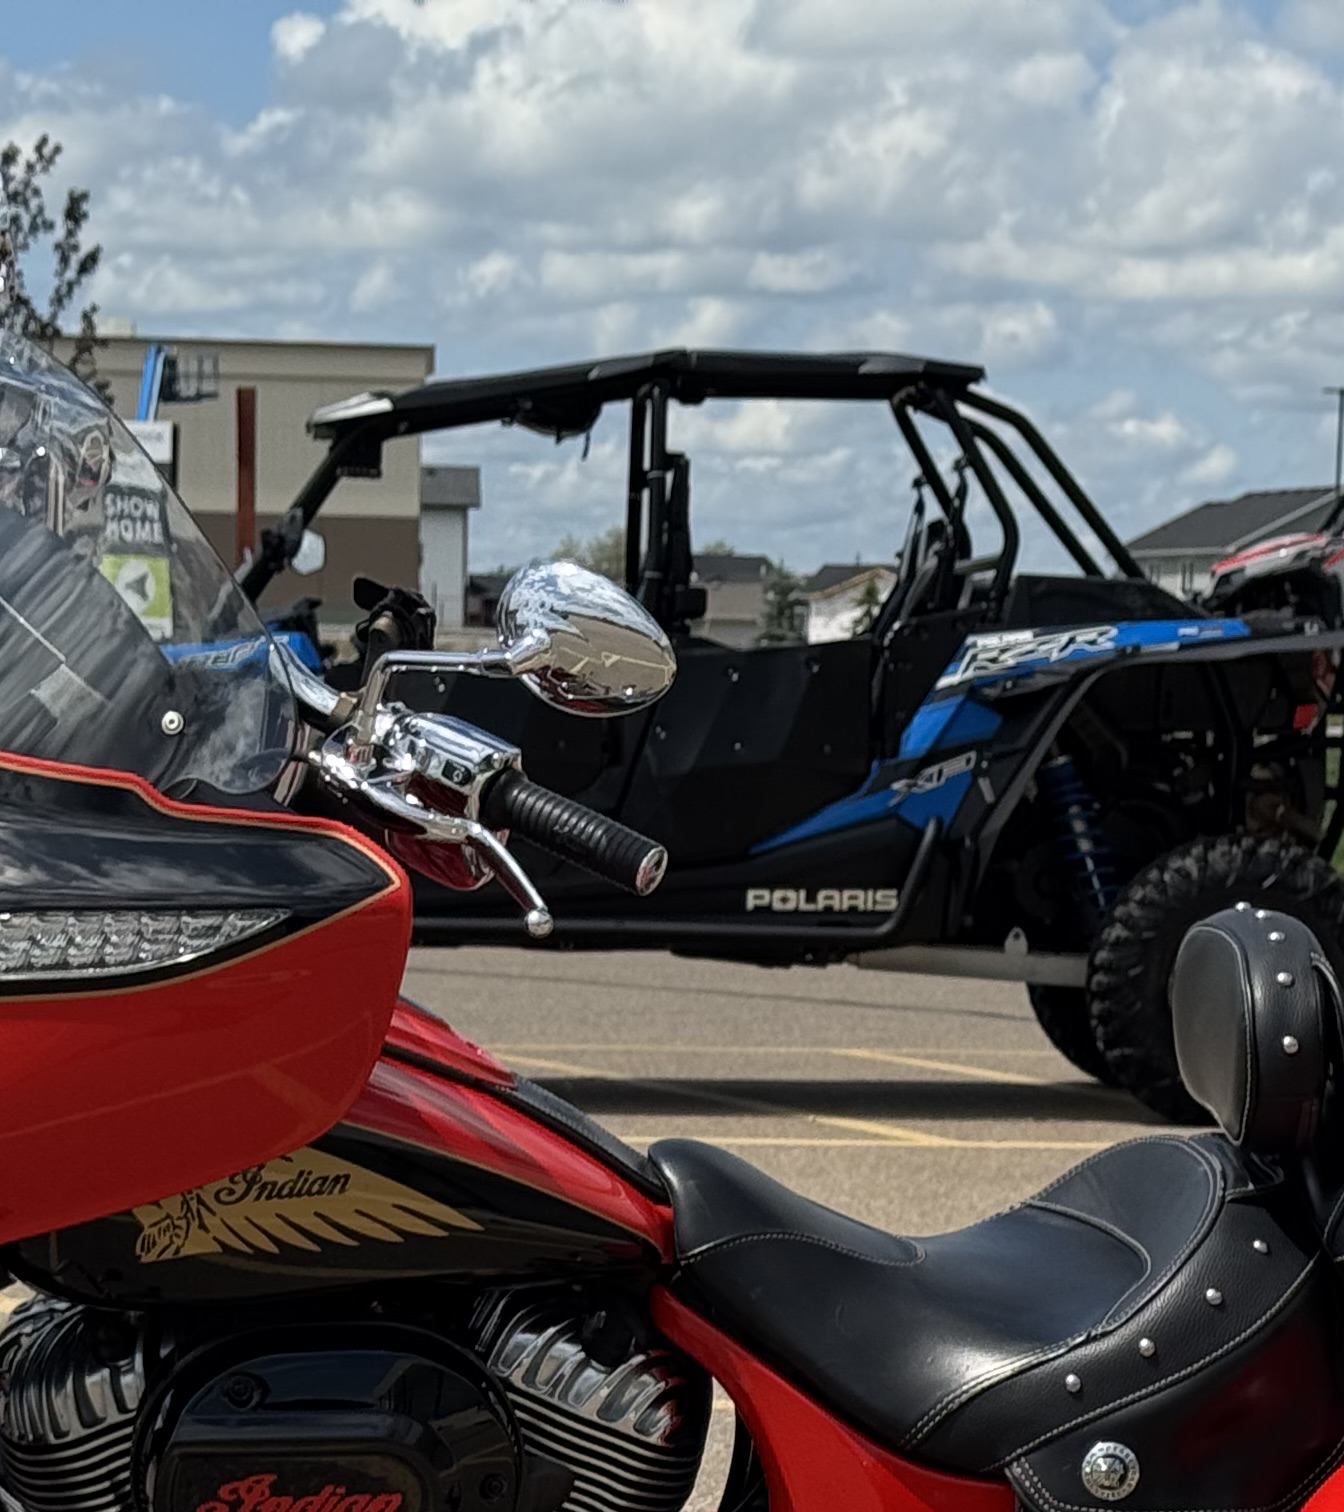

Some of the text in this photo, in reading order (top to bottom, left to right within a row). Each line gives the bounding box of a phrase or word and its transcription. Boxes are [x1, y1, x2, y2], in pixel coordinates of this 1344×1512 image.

[105, 492, 160, 519] SHOW
[105, 519, 165, 544] HOME
[746, 888, 898, 912] POLARIS
[214, 1164, 352, 1206] Indian
